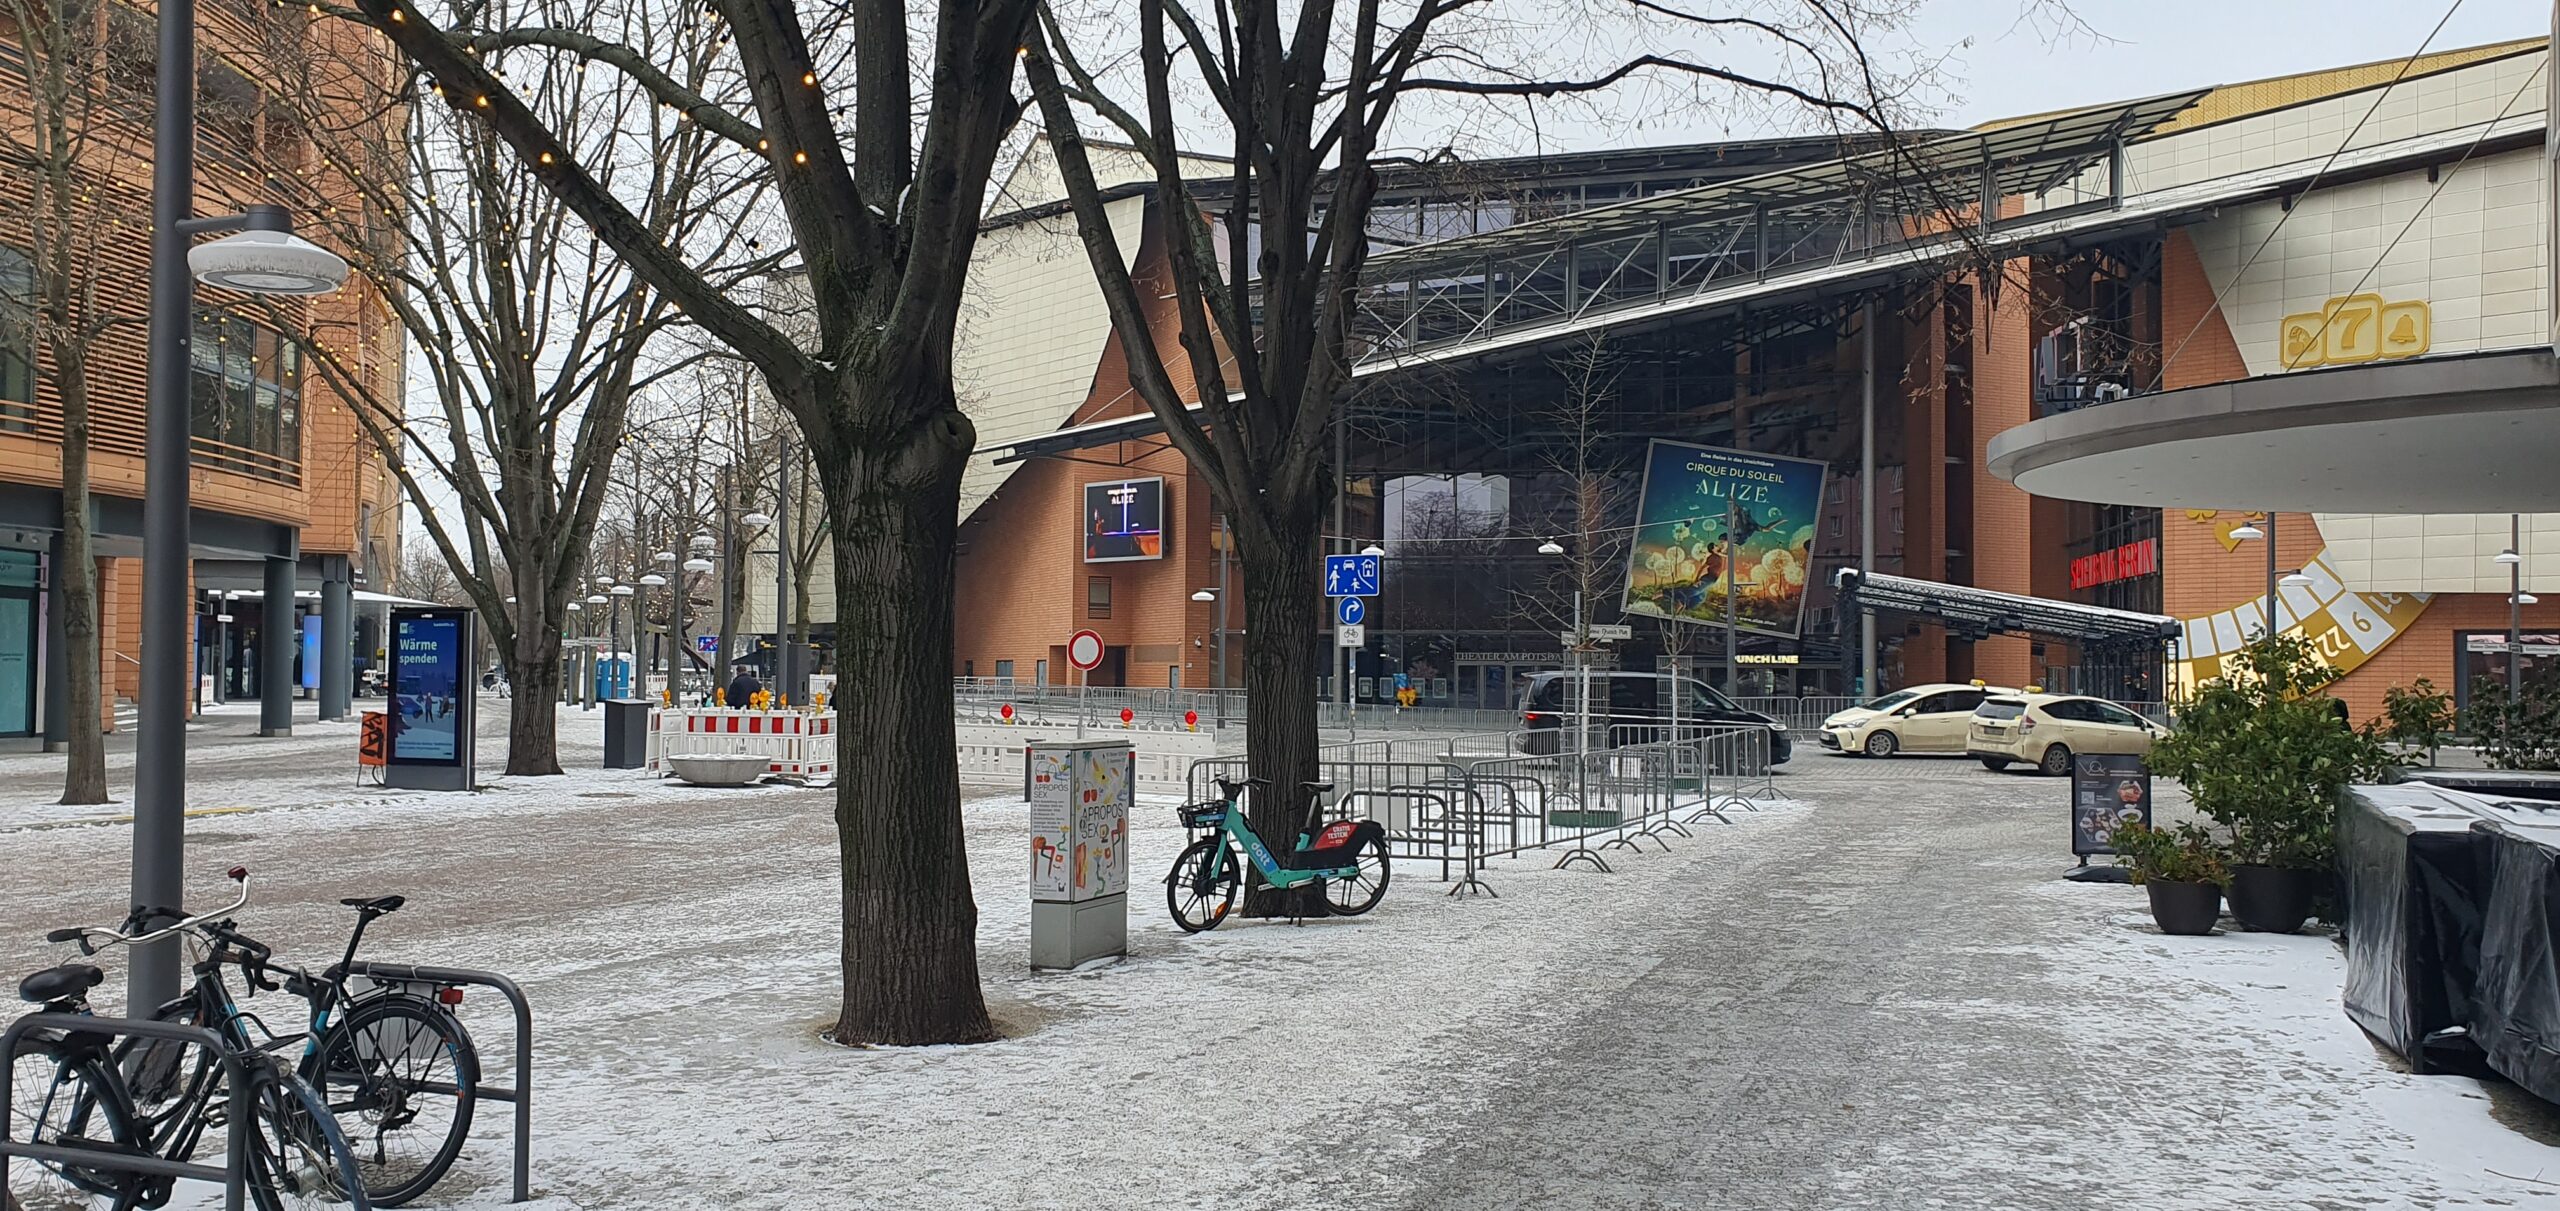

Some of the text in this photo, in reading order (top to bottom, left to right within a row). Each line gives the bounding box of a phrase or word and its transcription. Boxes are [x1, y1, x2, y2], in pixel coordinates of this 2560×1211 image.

[2333, 307, 2372, 350] 7
[1686, 462, 1785, 484] CIRQUE DU SOLEIL
[2118, 537, 2157, 579] BERLIN
[399, 638, 438, 651] Wärme
[2314, 625, 2351, 658] 22
[399, 653, 438, 666] spenden
[1456, 652, 1500, 661] THEATER
[1503, 652, 1521, 661] AM
[1033, 783, 1069, 792] APROPOS
[1033, 790, 1048, 799] SEX
[1081, 803, 1123, 820] APROPOS
[1081, 822, 1099, 839] SEX
[1251, 842, 1270, 866] dott
